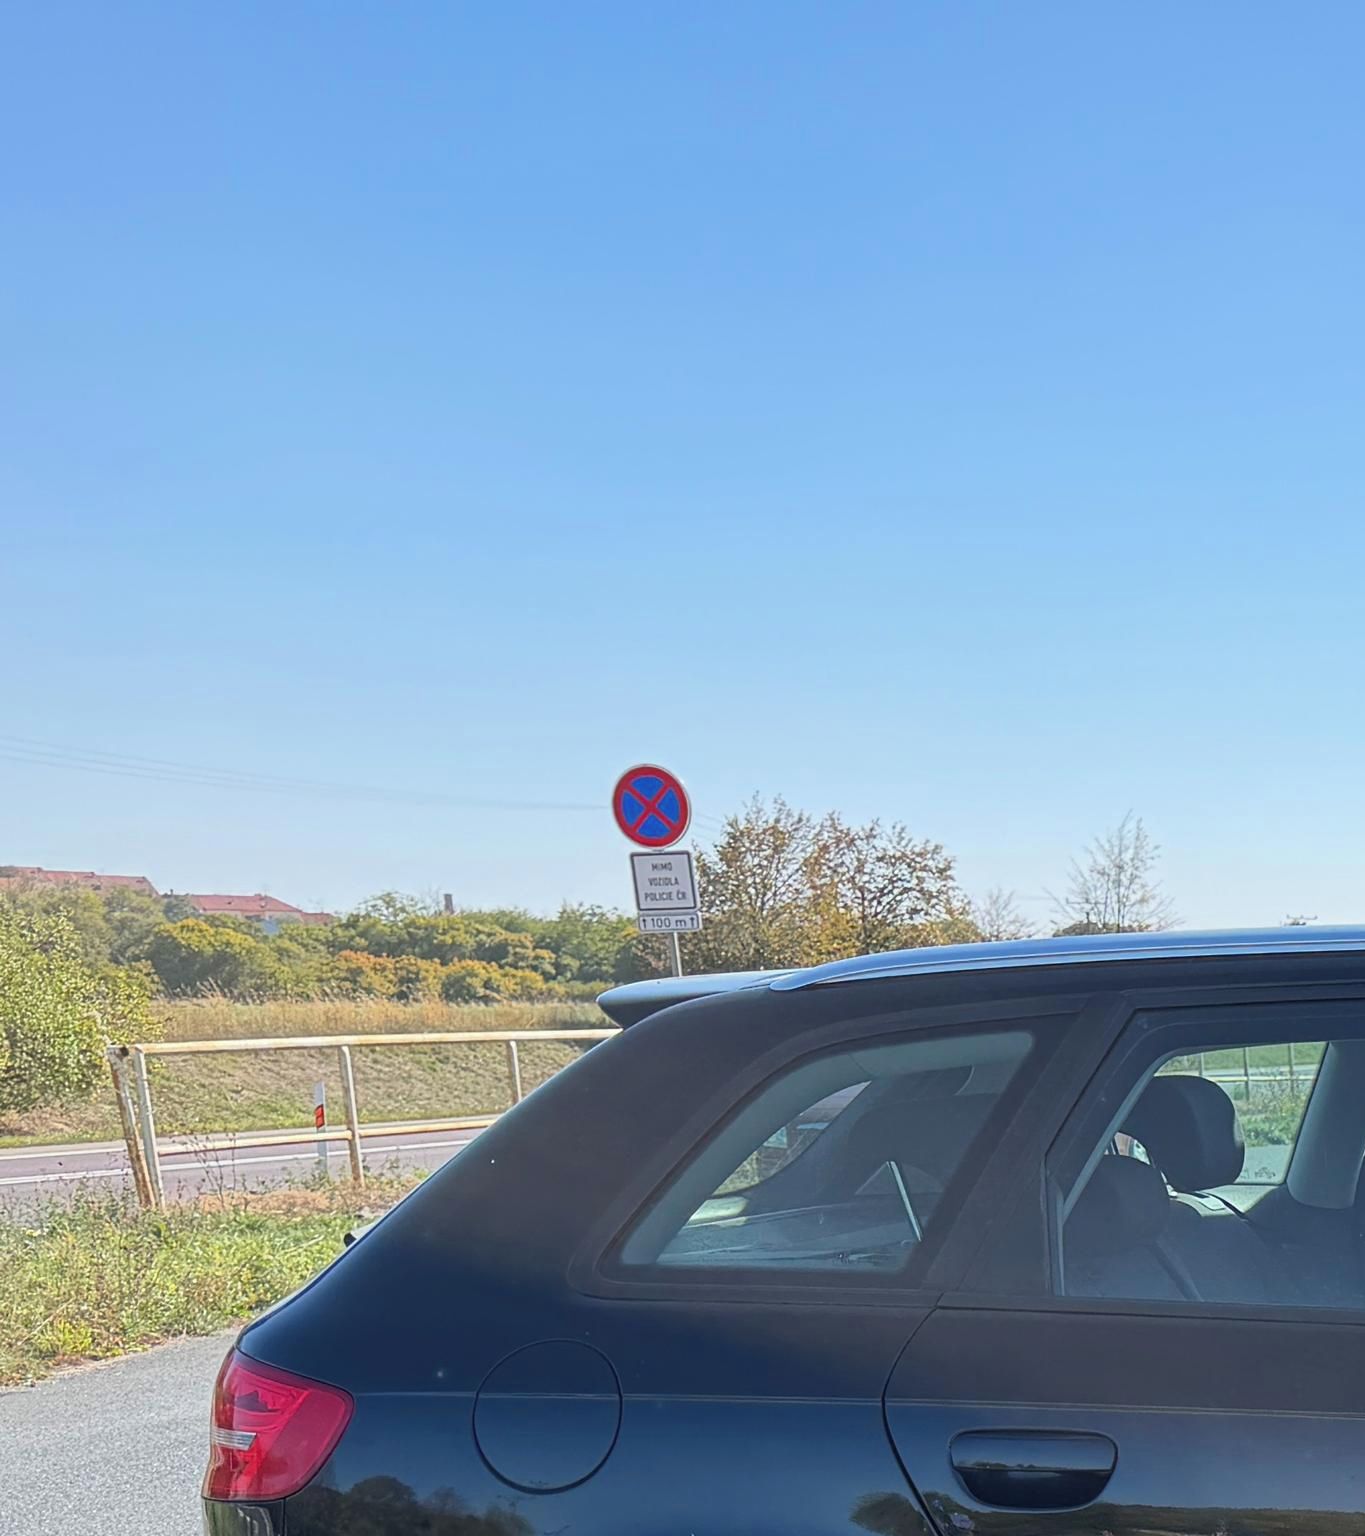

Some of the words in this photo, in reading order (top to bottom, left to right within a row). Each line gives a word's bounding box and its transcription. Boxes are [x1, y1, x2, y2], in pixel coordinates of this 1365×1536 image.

[651, 862, 672, 871] MIMO
[648, 877, 679, 886] VOZIDLA
[644, 891, 673, 901] POLICIE
[651, 917, 671, 929] 100
[675, 919, 687, 927] m
